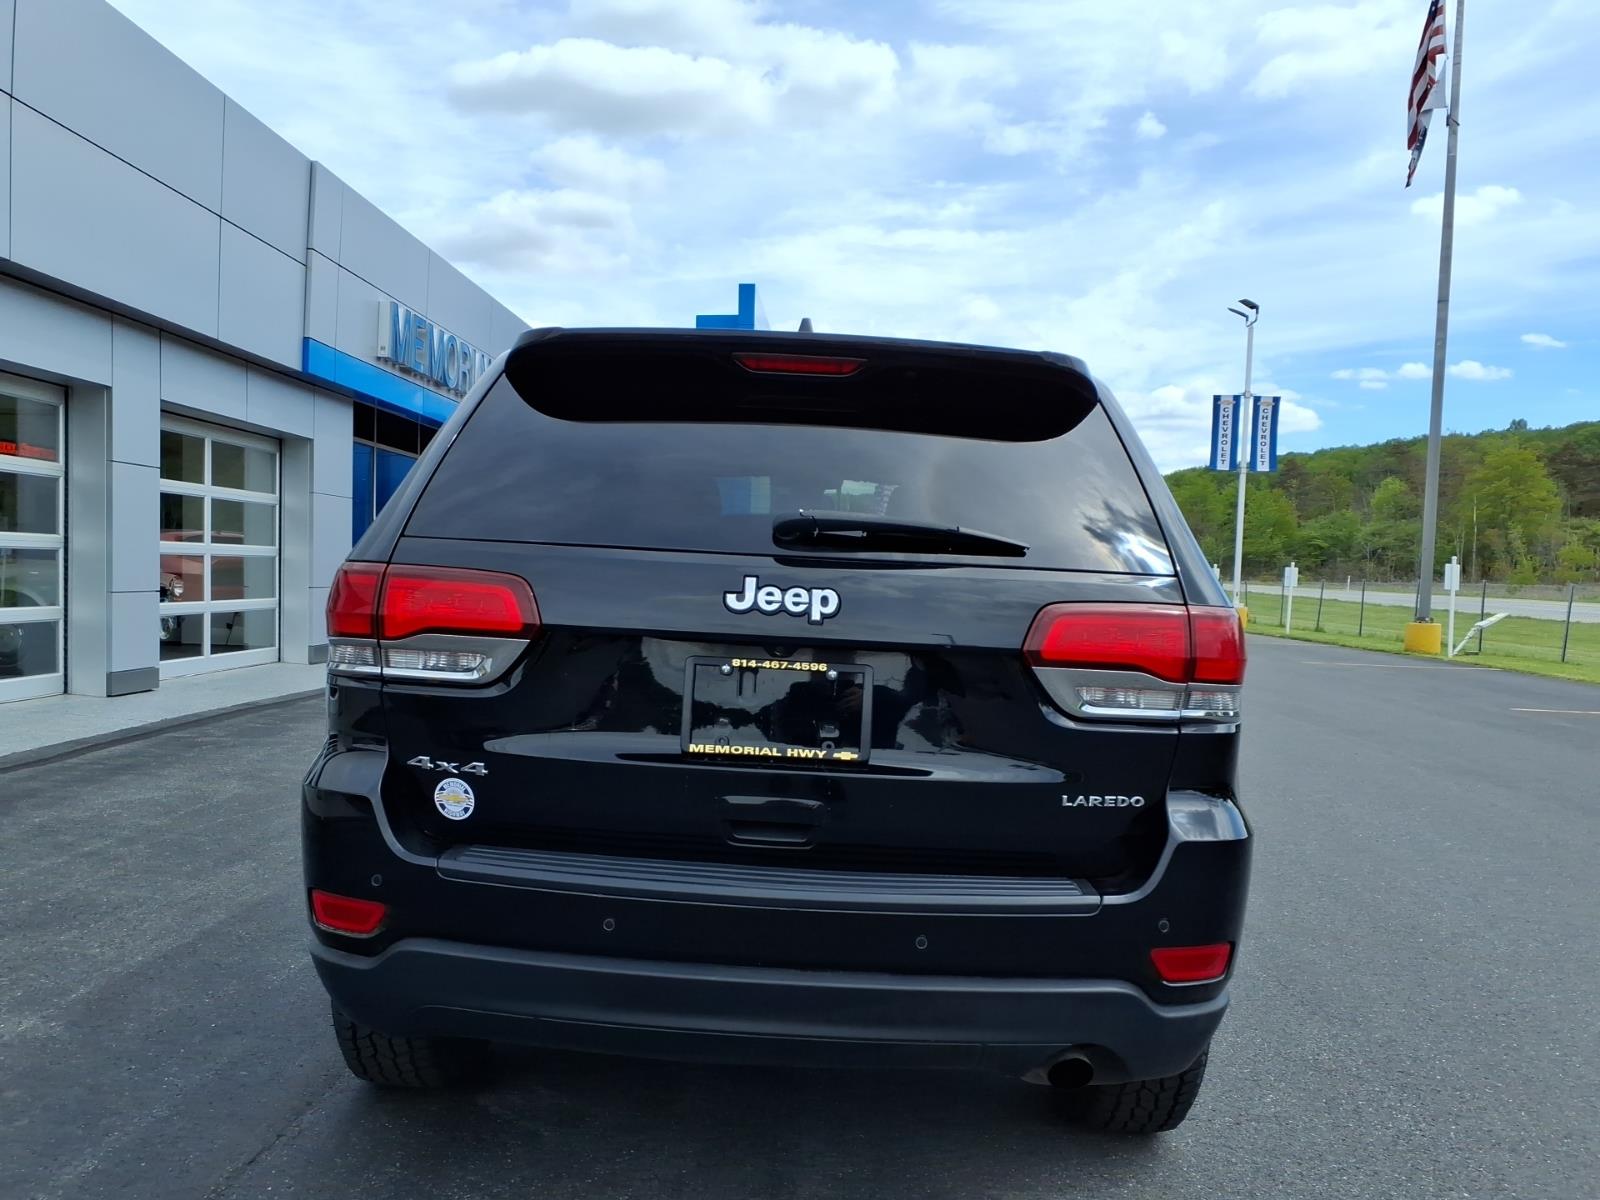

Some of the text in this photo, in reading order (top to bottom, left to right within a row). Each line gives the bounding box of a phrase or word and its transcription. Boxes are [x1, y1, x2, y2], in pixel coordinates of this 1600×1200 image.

[1220, 406, 1230, 465] CHEVROLET
[1260, 407, 1269, 466] CHEVROLET
[725, 576, 839, 622] Jeep
[731, 658, 828, 672] 814-467-4596
[689, 743, 828, 760] MEMORIAL HWY
[406, 755, 489, 776] 4x4
[1061, 794, 1145, 807] LAREDO
